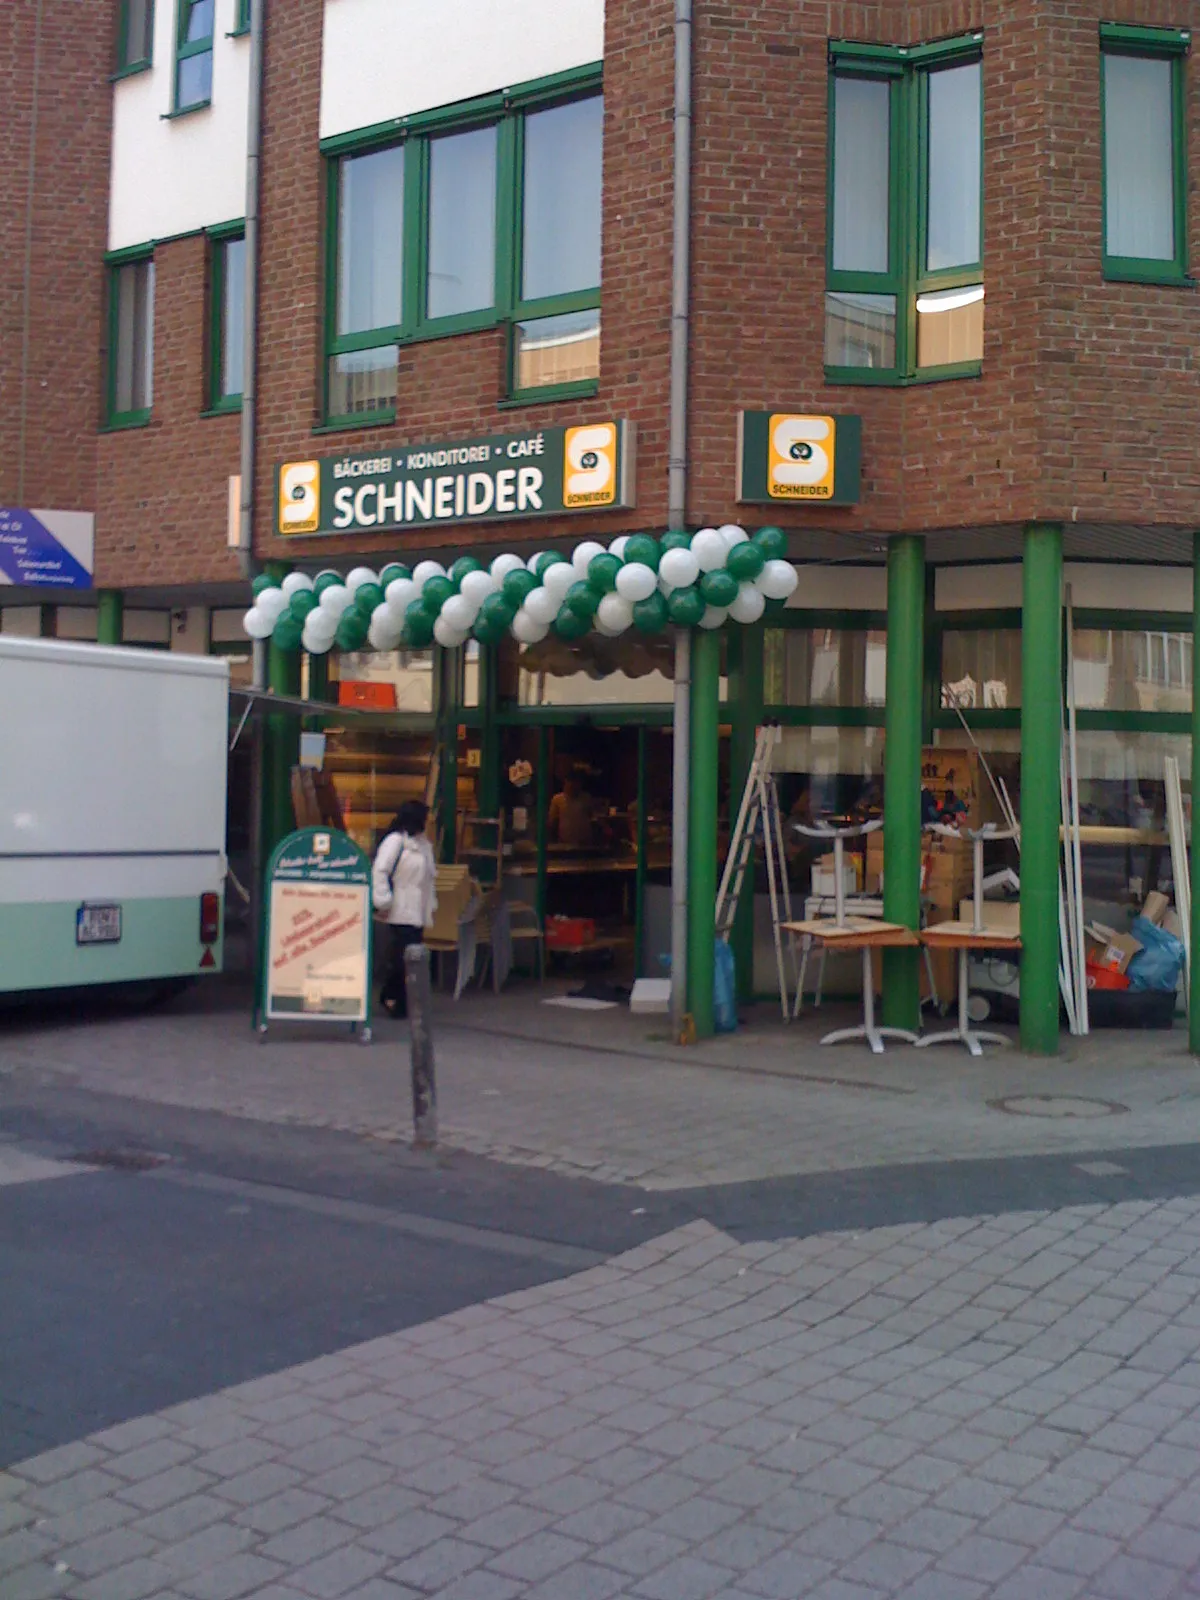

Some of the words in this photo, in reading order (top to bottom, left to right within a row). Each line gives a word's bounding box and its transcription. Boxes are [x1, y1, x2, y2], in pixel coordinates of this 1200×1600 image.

[333, 458, 392, 479] BÄCKEREI
[407, 445, 490, 469] KONDITOREI
[507, 433, 545, 458] CAFÉ
[332, 467, 543, 528] SCHNEIDER
[773, 485, 828, 495] SCHNEIDER
